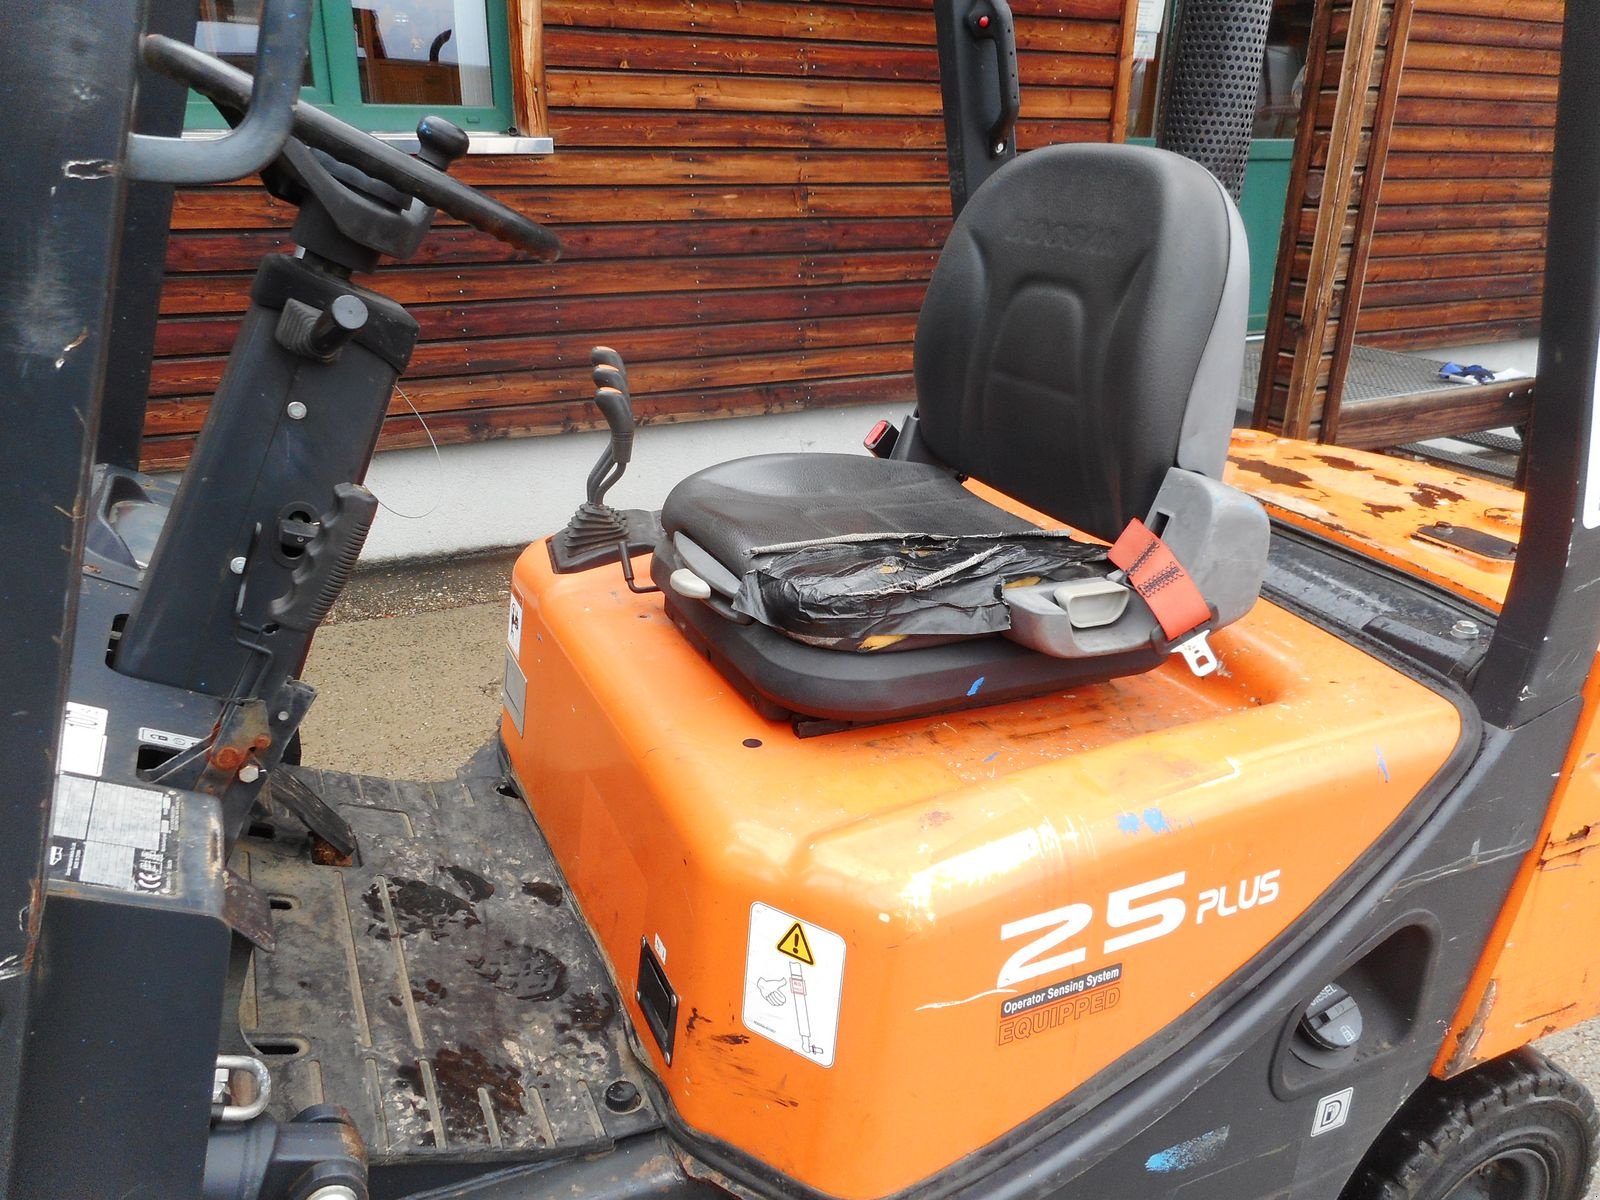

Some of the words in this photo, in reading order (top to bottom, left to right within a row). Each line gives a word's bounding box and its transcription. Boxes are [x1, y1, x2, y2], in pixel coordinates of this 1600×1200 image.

[997, 871, 1186, 990] 25
[1196, 869, 1281, 925] PLUS
[998, 987, 1121, 1046] EQUIPPED
[1003, 990, 1045, 1014] Operator
[1047, 979, 1084, 1001] Sensing
[1086, 967, 1120, 989] System
